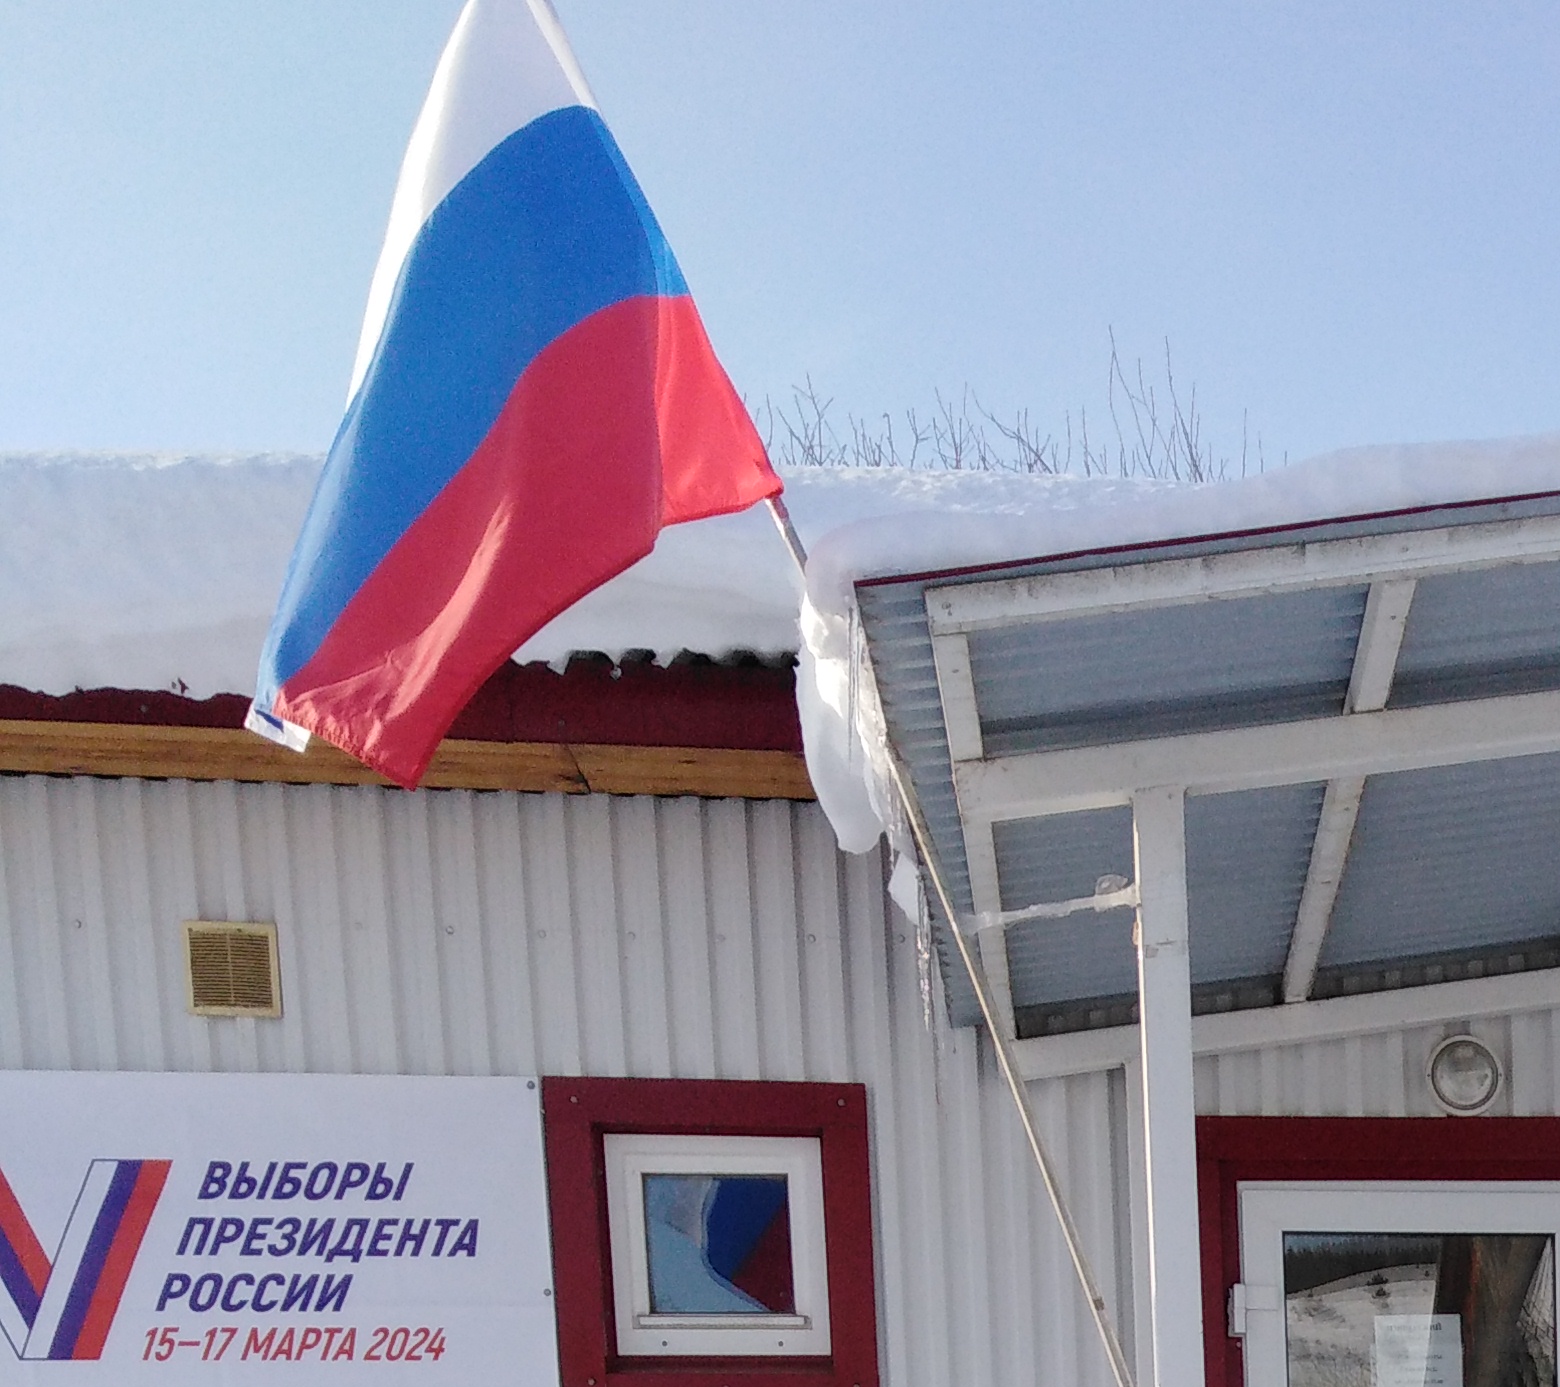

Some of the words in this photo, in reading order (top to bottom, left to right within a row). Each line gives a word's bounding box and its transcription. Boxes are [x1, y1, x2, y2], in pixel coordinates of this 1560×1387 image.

[197, 1160, 415, 1202] ВЫБОРЫ
[175, 1216, 480, 1264] ПРЕЗИДЕНТА
[155, 1272, 354, 1313] РОССИИ
[240, 1327, 356, 1362] МАРТА
[363, 1327, 446, 1362] 2024
